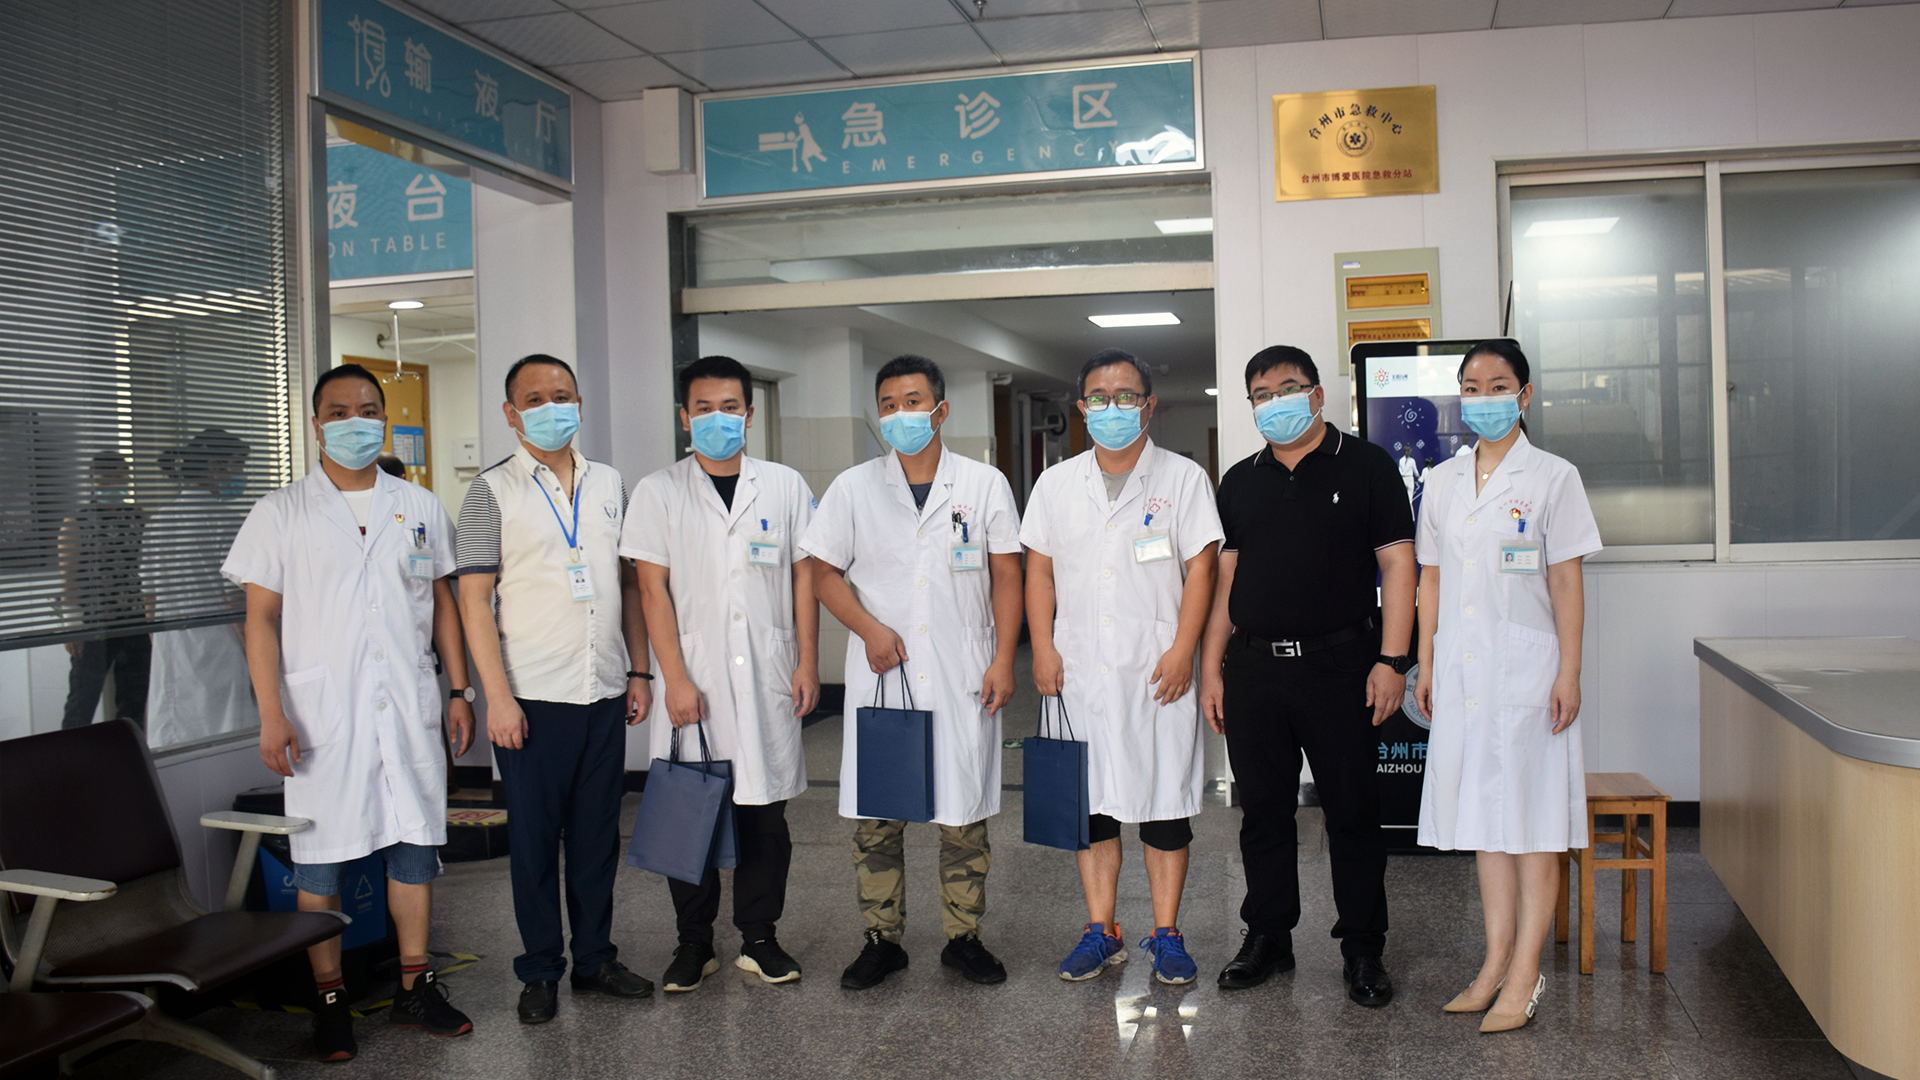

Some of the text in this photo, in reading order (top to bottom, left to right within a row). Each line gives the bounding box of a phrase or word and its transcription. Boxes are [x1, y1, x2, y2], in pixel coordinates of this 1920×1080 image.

[841, 82, 1118, 150] 急诊区
[1308, 103, 1402, 140] 台州市急救中心
[841, 140, 1119, 174] EMERGENCY
[370, 231, 447, 255] TABLE
[1376, 763, 1423, 774] AIZHOU
